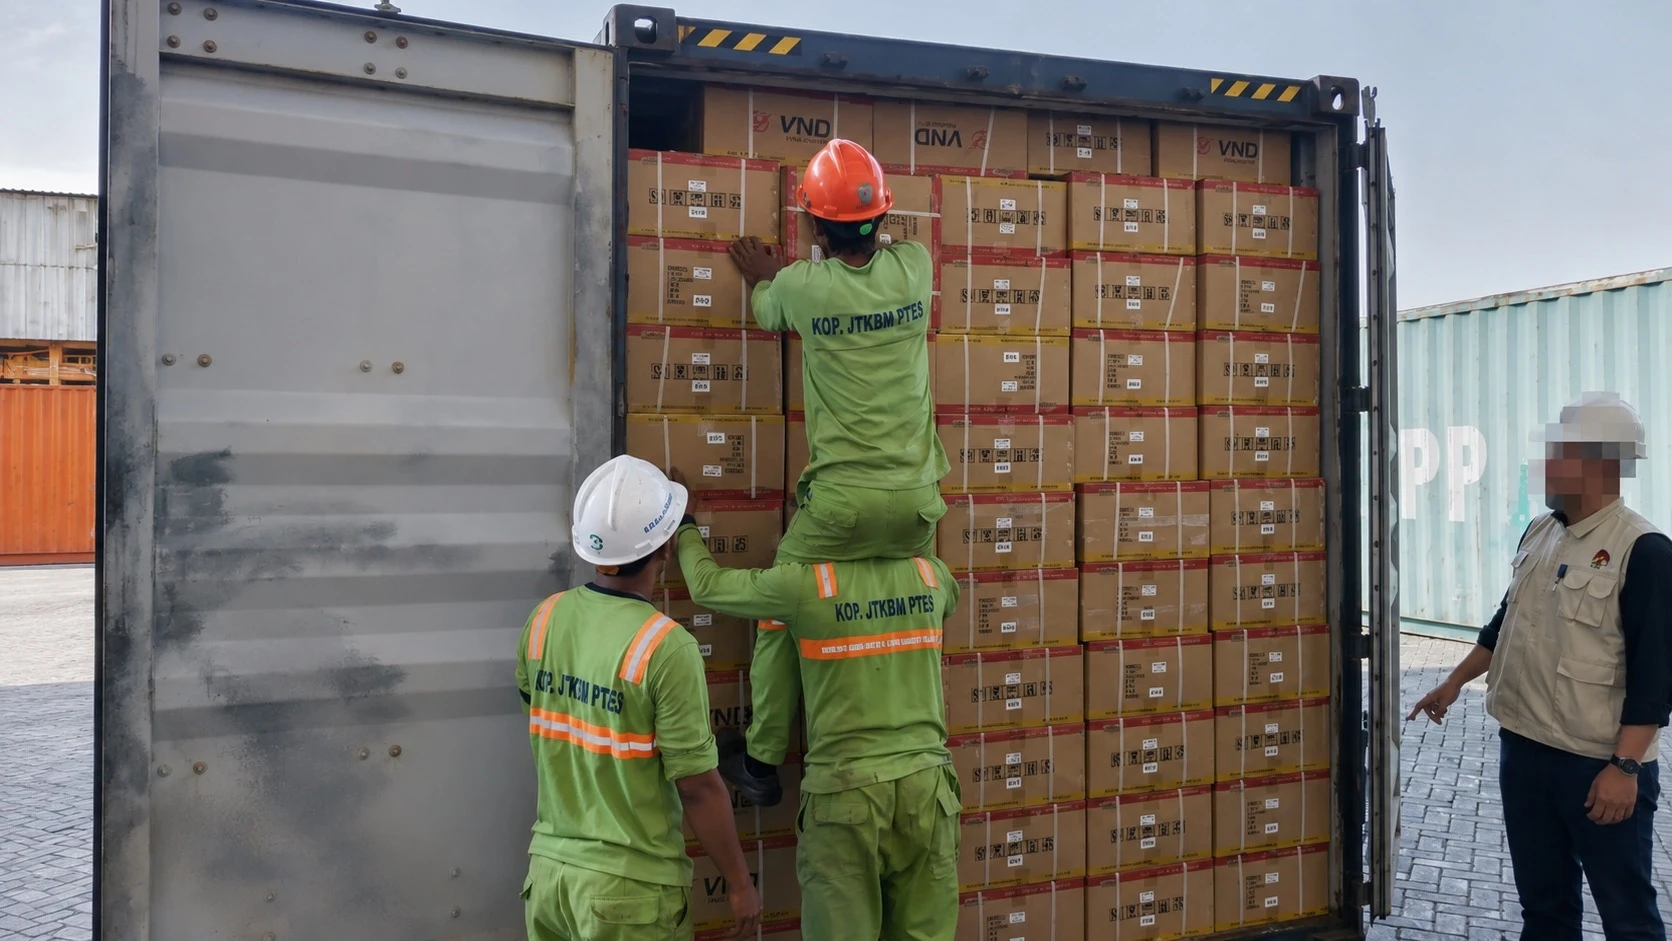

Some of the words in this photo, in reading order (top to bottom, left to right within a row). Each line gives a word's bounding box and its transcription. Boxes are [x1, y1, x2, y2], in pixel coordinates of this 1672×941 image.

[780, 115, 831, 138] VND
[914, 128, 962, 148] VND
[1219, 140, 1258, 159] VND
[812, 317, 843, 336] KOP.
[847, 311, 894, 334] JTKBM
[896, 300, 924, 325] PTES
[835, 602, 863, 622] KOP.
[866, 597, 907, 620] JTKBM
[908, 594, 934, 615] PTES
[591, 684, 624, 715] PTES
